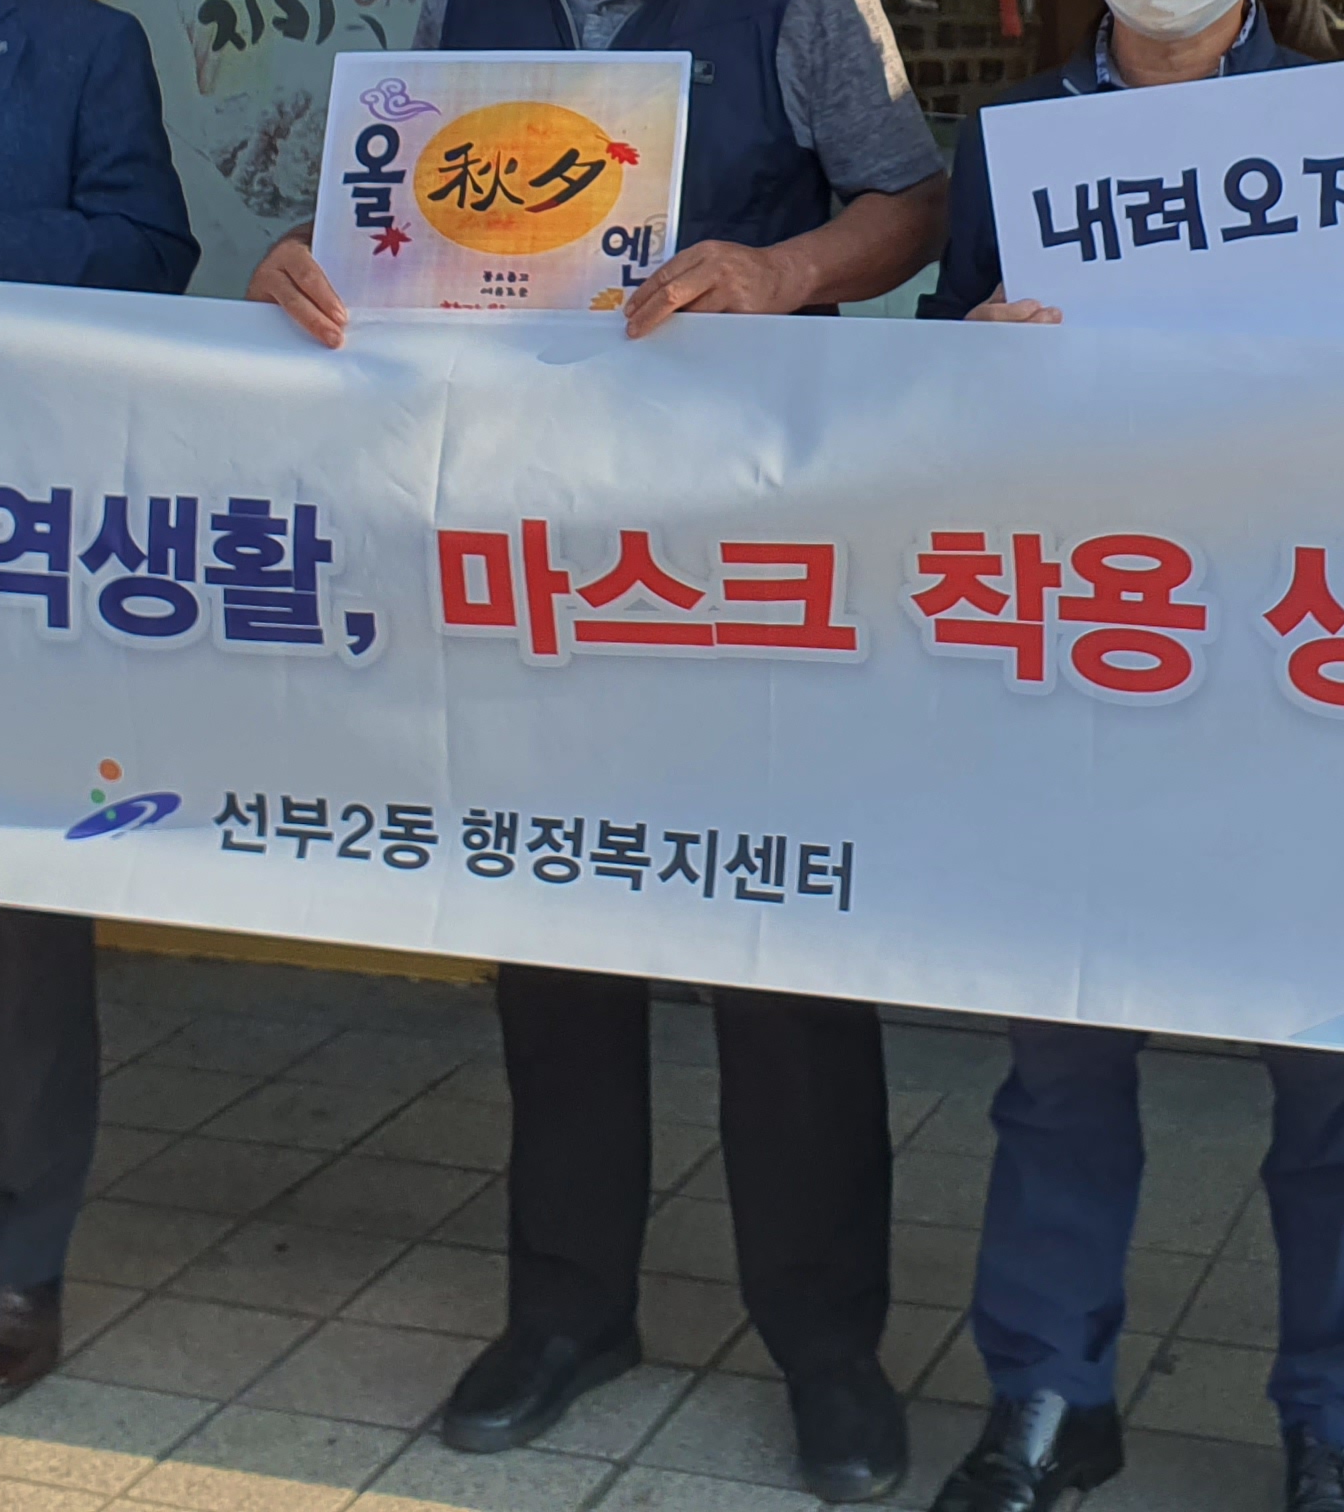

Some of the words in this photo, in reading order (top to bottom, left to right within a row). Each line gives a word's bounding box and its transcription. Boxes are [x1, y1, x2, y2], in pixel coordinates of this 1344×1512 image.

[343, 123, 407, 228] 올
[427, 141, 606, 213] 秋夕
[601, 225, 653, 287] 엔
[438, 519, 857, 654] 마스크
[913, 532, 1206, 692] 착용
[215, 790, 439, 869] 선부2동
[461, 807, 856, 911] 행정복지센터
